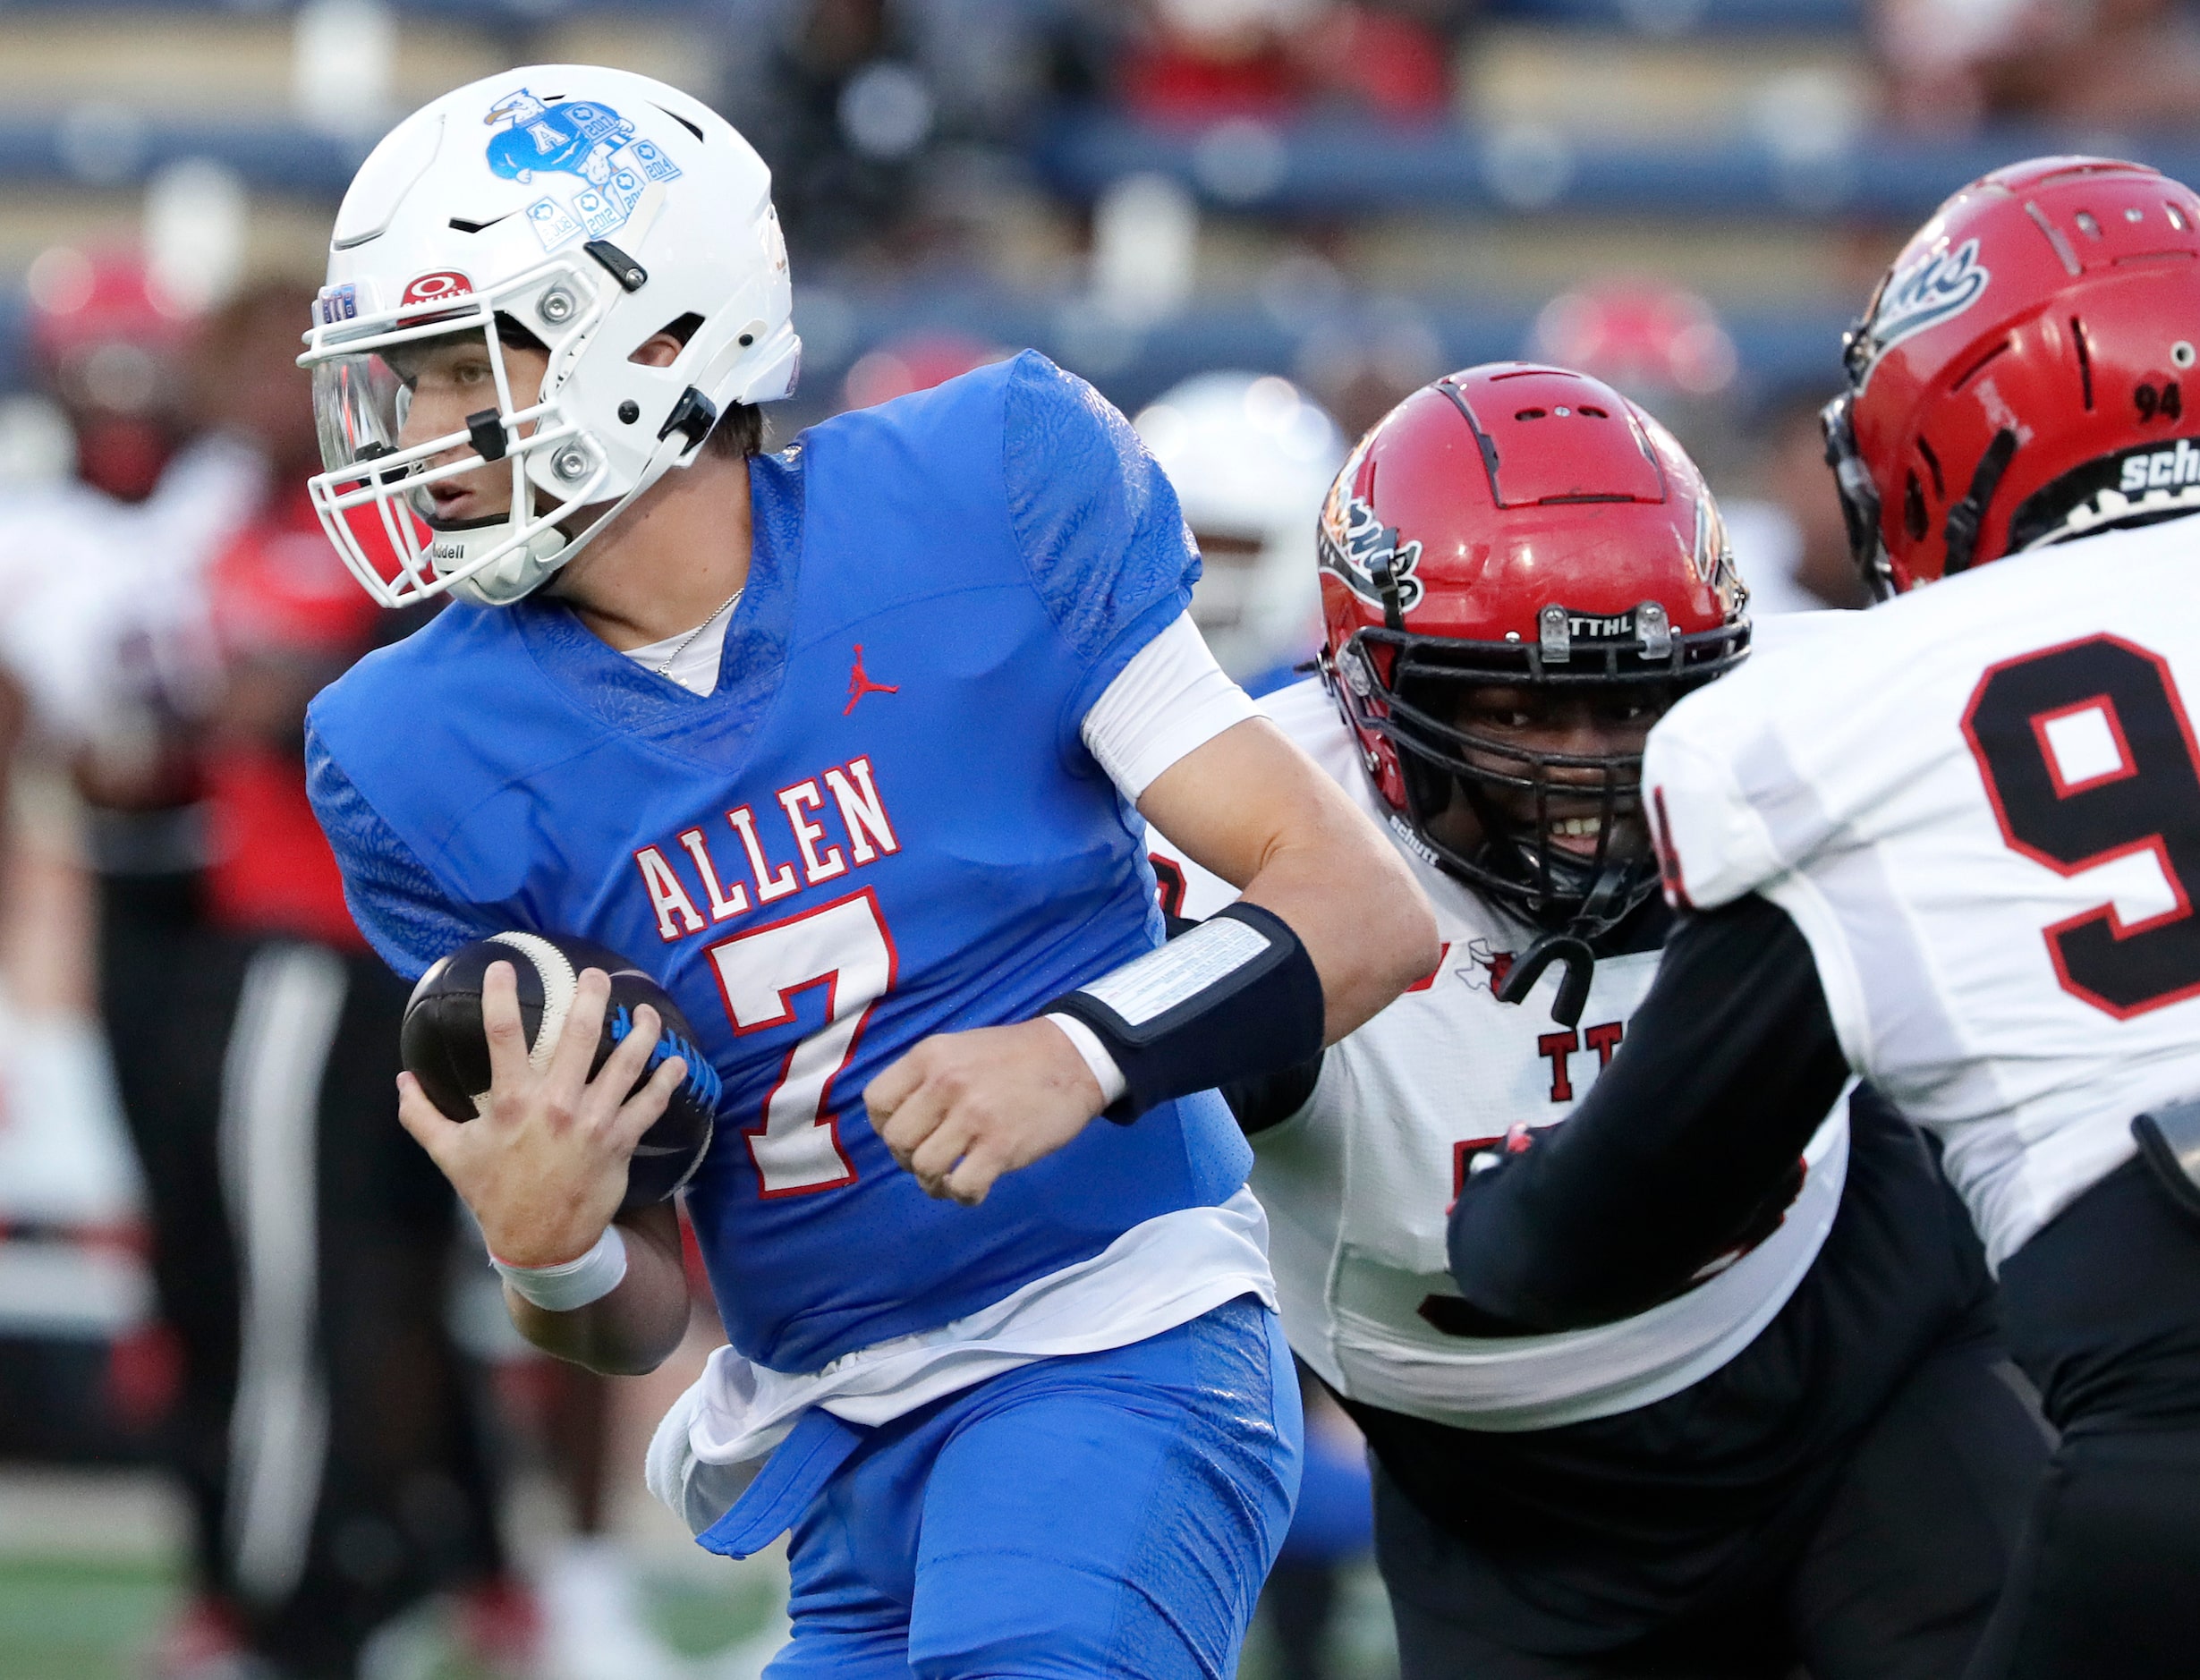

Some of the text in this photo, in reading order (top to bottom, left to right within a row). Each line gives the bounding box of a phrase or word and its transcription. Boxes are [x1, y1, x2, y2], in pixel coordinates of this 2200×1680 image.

[527, 120, 571, 156] A
[584, 115, 614, 136] 2017
[646, 158, 672, 178] 2014
[624, 185, 644, 209] 201
[587, 208, 616, 233] 2012
[2135, 382, 2182, 427] 94
[1568, 615, 1632, 636] TTHL
[1389, 814, 1440, 866] schutt
[1958, 631, 2200, 1022] 9
[633, 754, 901, 942] ALLEN
[702, 885, 898, 1200] 7
